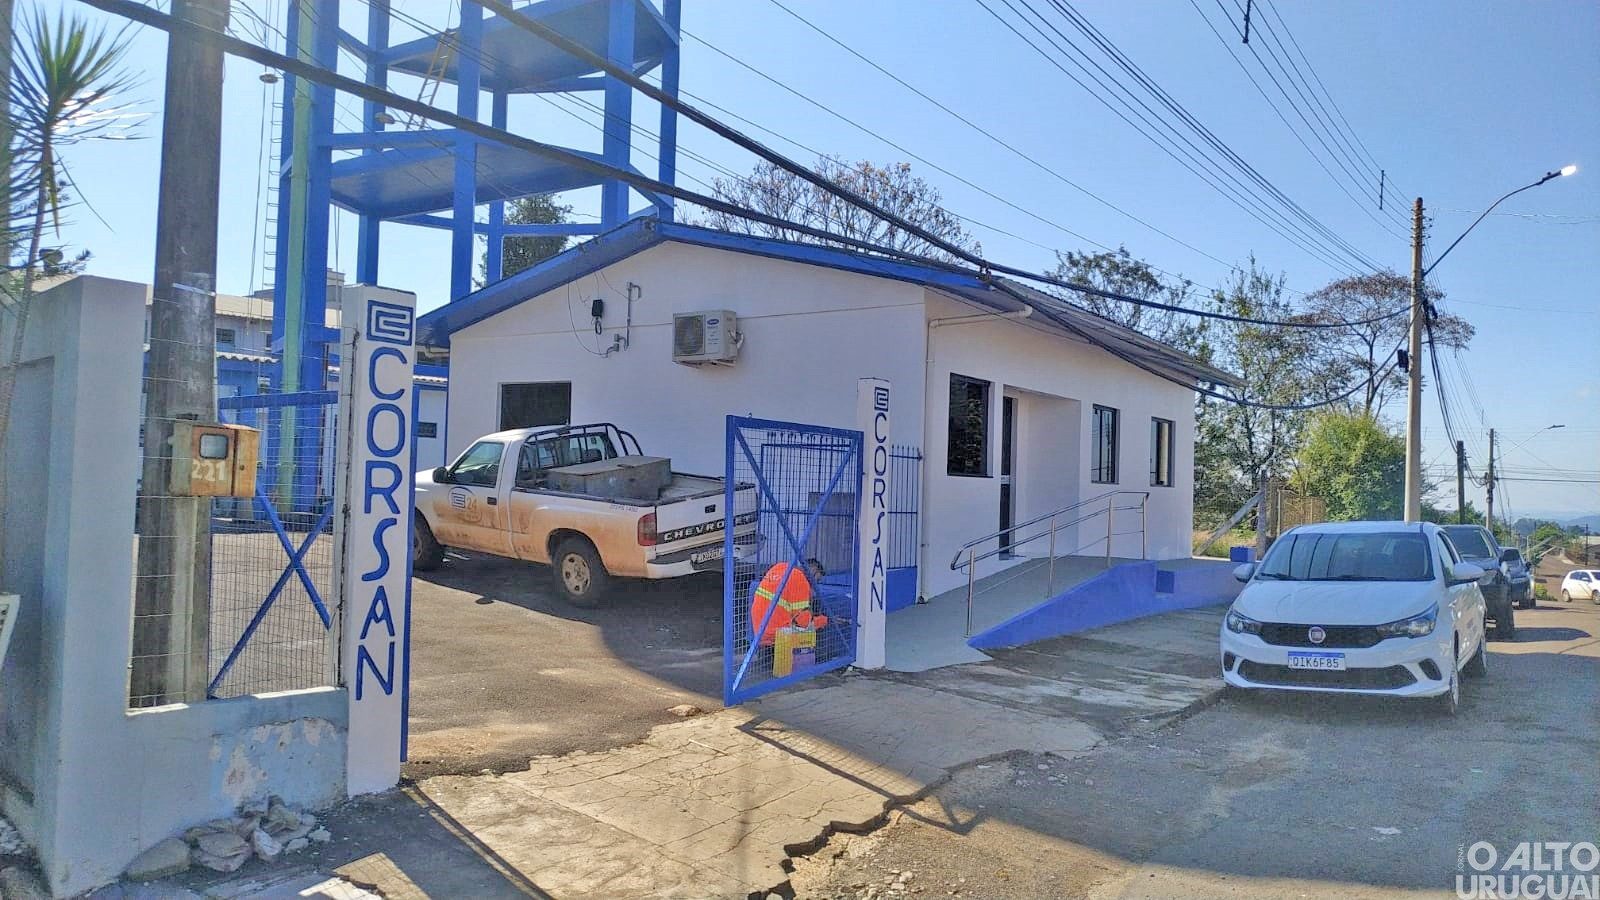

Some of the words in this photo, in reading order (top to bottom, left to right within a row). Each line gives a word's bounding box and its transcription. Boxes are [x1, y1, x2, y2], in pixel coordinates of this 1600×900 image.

[191, 459, 226, 482] 221
[356, 346, 408, 700] CORSAN
[663, 514, 754, 541] CHEVROET
[870, 412, 887, 613] CORSAN
